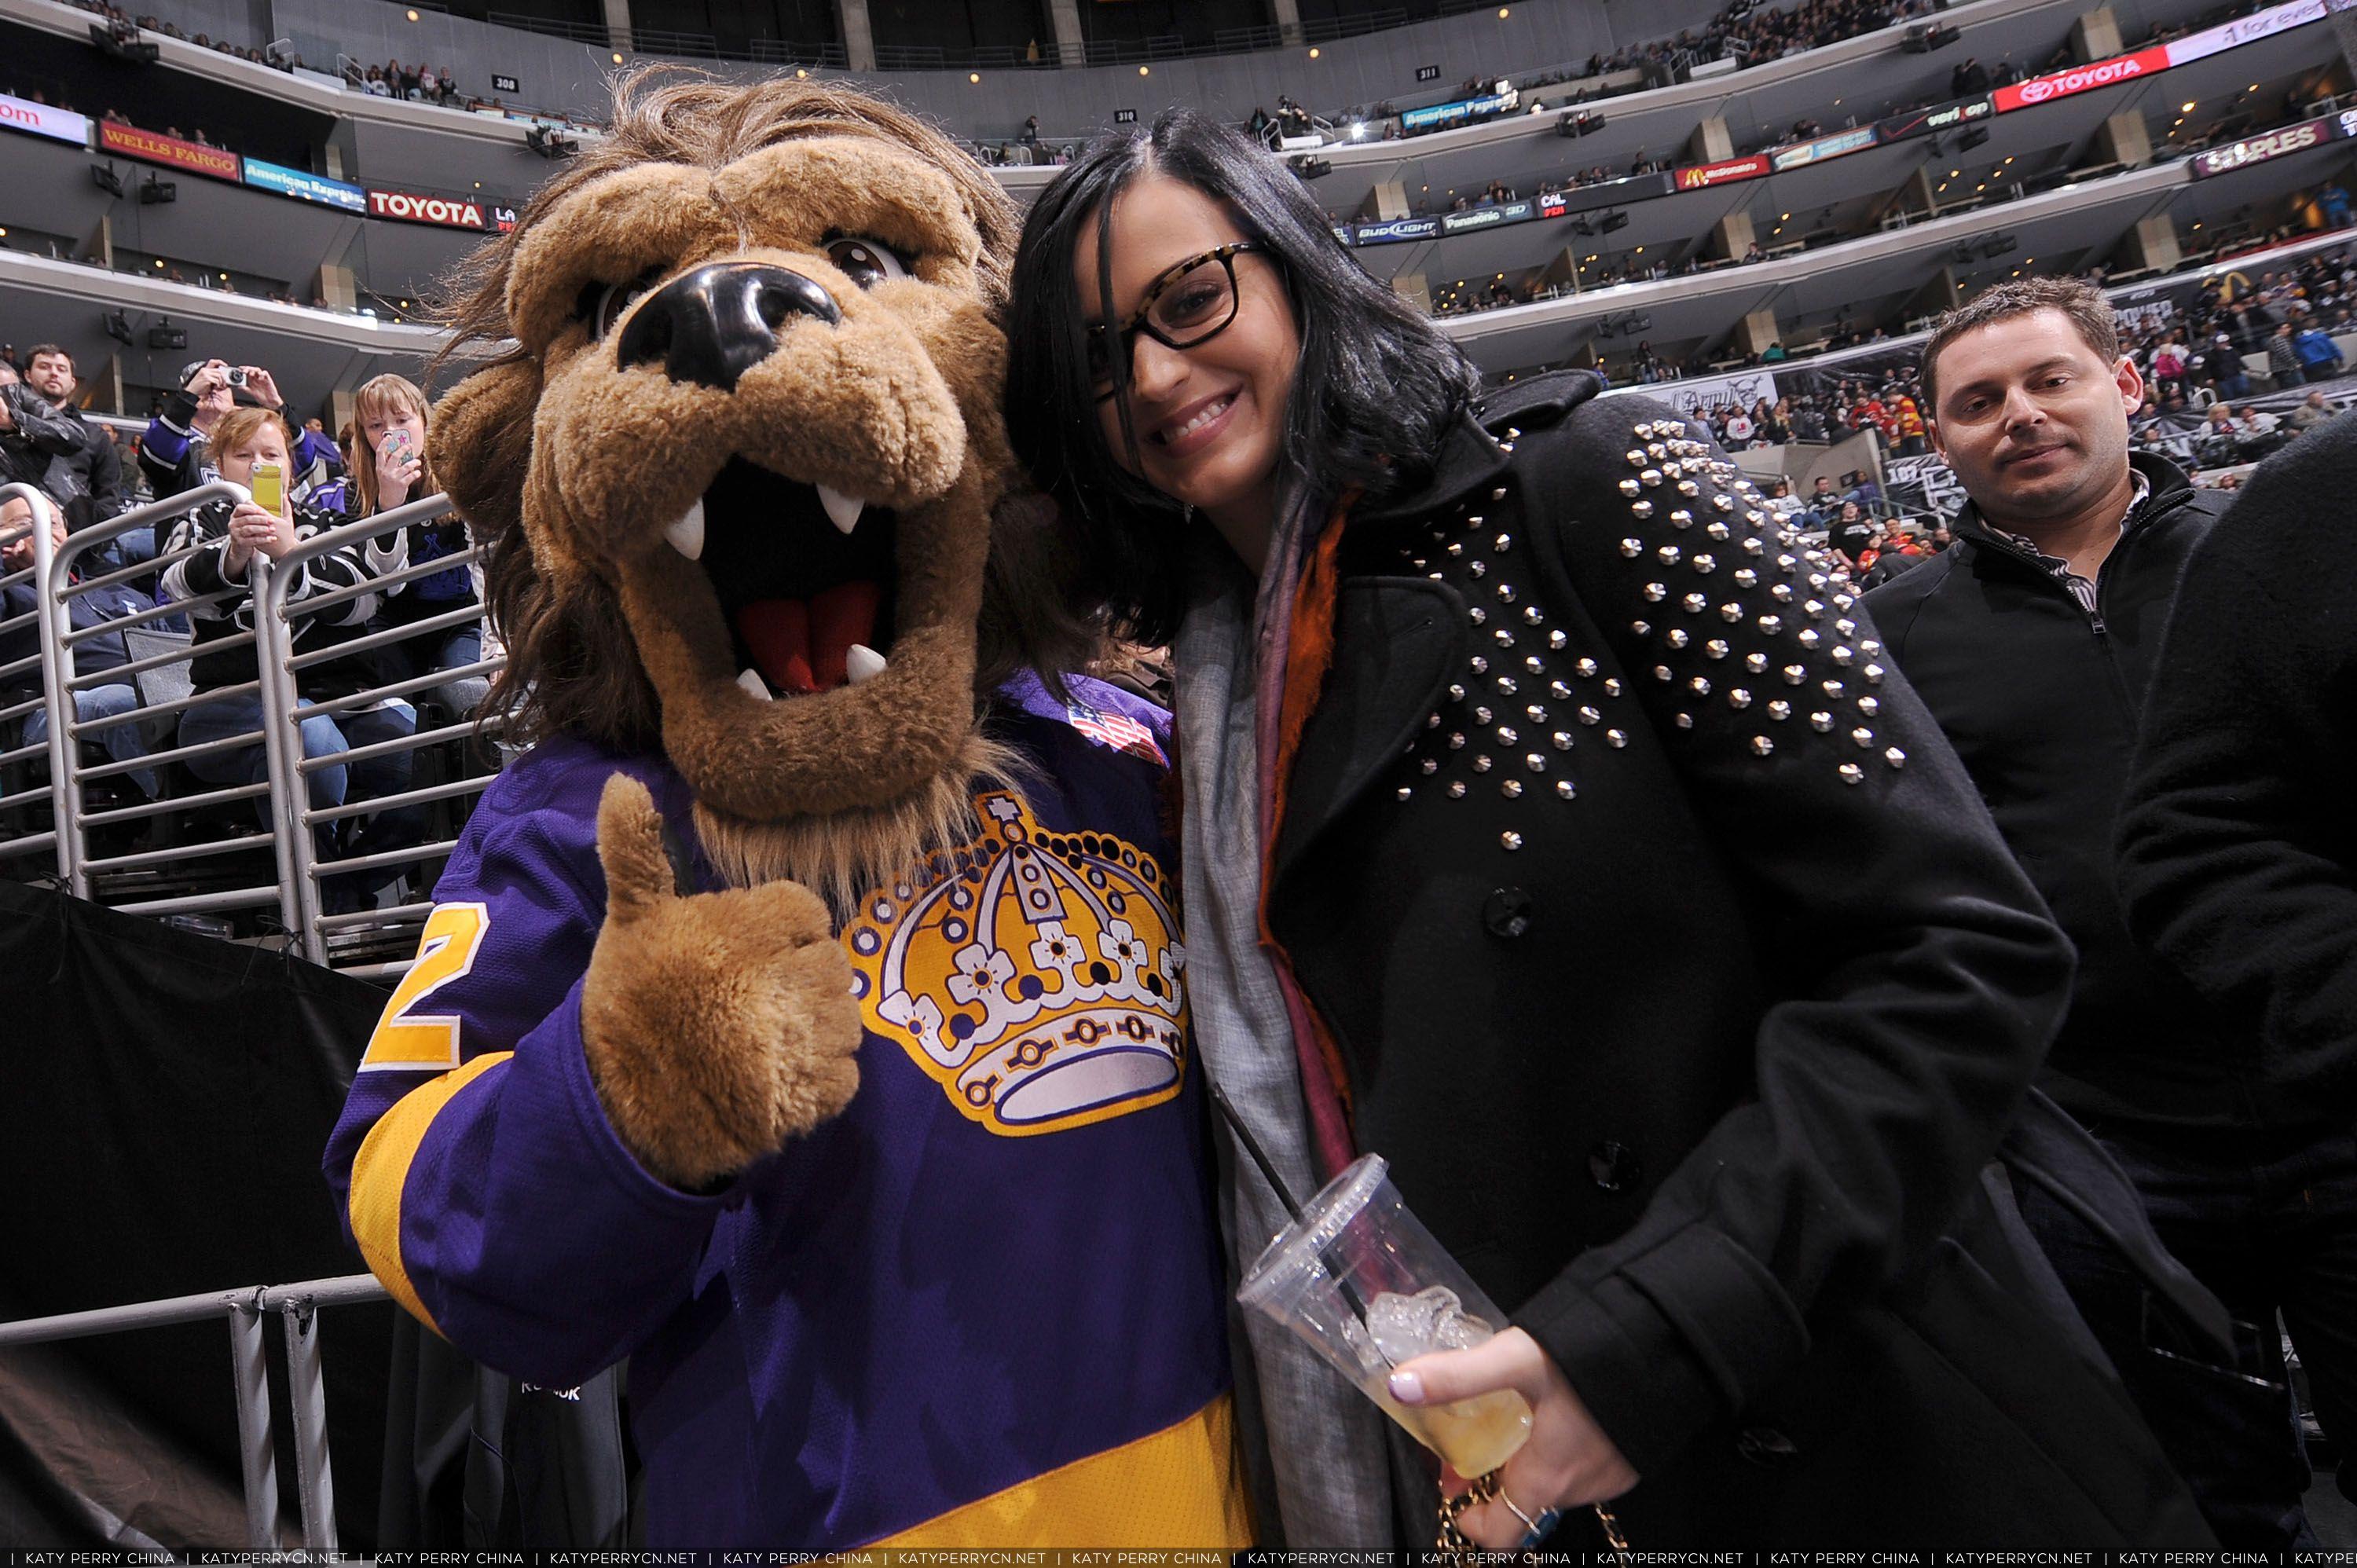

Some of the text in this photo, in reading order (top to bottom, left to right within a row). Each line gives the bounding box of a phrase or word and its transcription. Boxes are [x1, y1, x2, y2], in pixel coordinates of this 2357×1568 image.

[497, 77, 515, 90] 308
[1420, 68, 1435, 79] 311
[2052, 59, 2142, 93] TOYOTA
[1118, 111, 1135, 122] 310
[1406, 104, 1465, 126] American
[1927, 101, 1989, 127] verizon
[104, 128, 236, 172] WELLS FARGO
[245, 163, 310, 190] American
[370, 191, 483, 226] TOYOTA
[1541, 192, 1567, 208] CAL
[495, 207, 516, 222] LA
[1446, 204, 1527, 229] Panasonic 3D
[1358, 222, 1436, 238] BUD LIGHT
[357, 901, 491, 1074] 2
